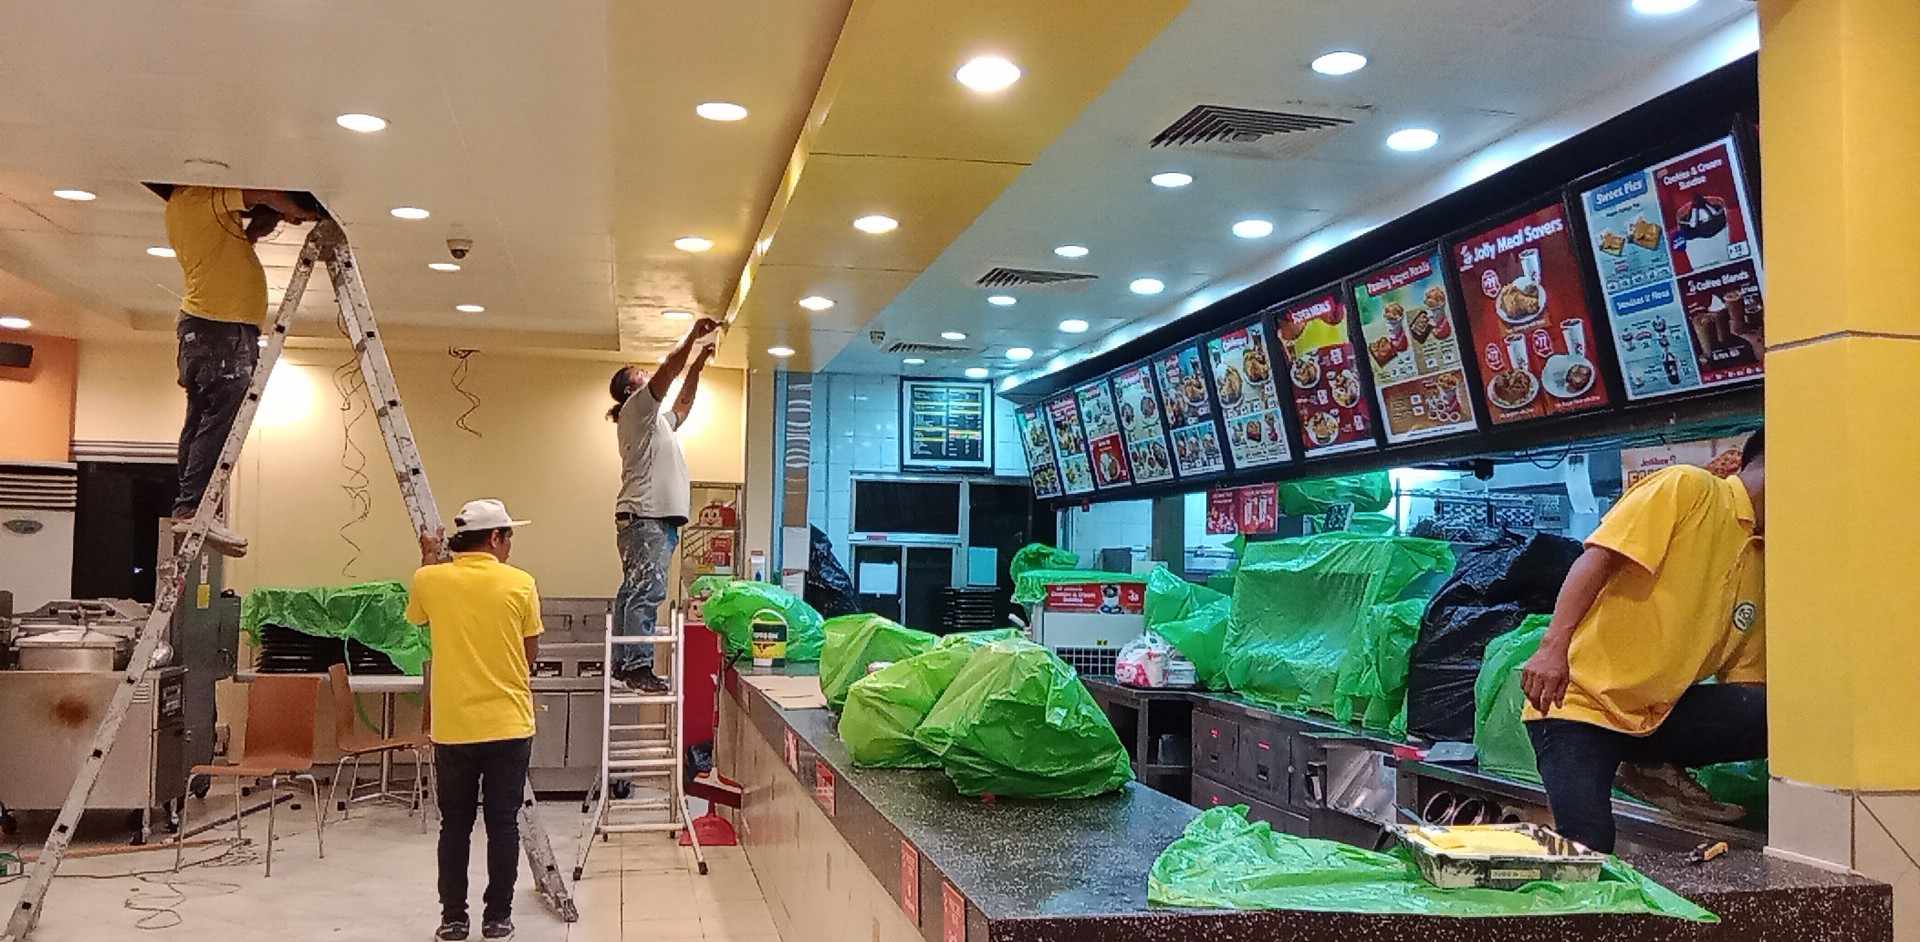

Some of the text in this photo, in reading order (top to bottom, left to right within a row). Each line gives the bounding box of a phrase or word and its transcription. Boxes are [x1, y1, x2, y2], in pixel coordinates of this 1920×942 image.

[1596, 180, 1643, 205] Sweet Pies
[1474, 218, 1564, 263] Jolly Meal Savers
[1366, 278, 1392, 295] Family
